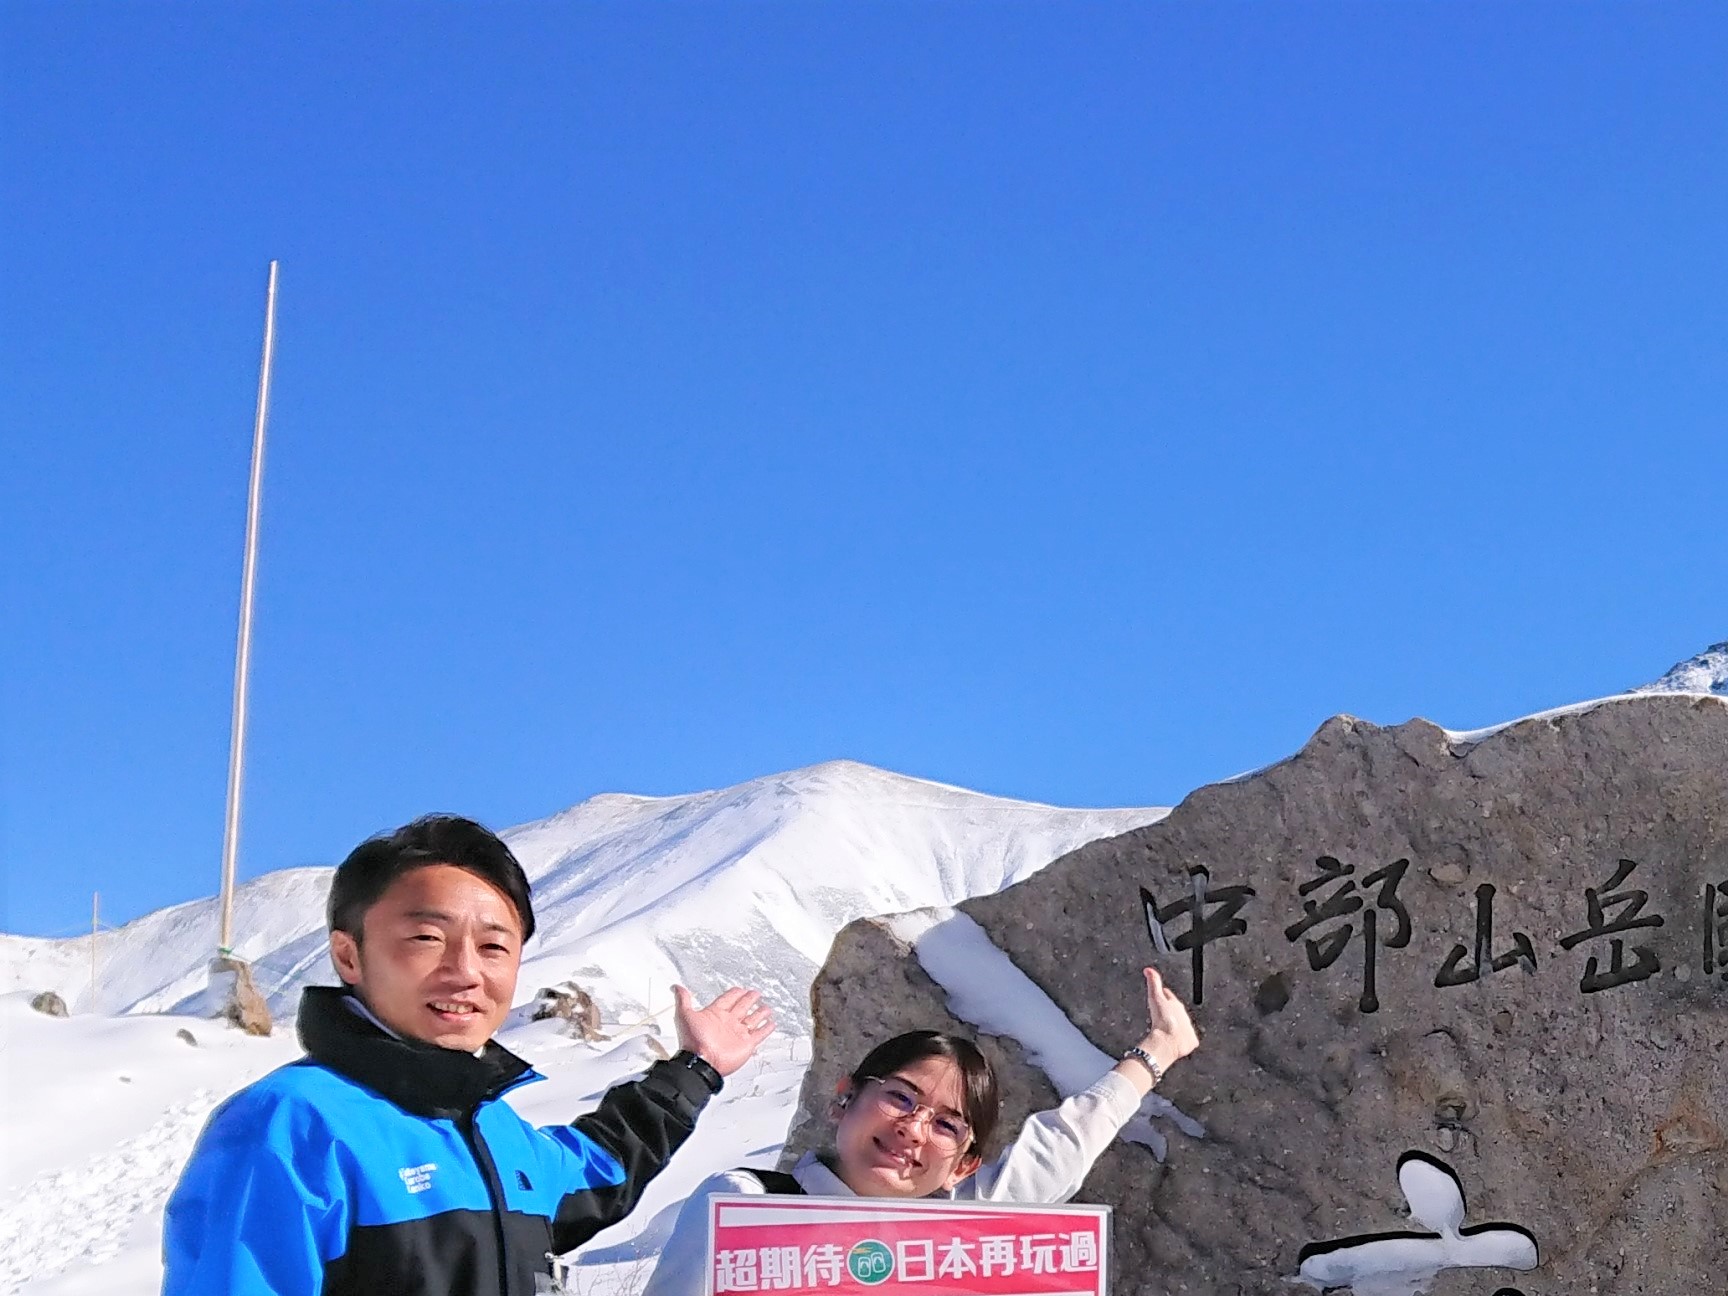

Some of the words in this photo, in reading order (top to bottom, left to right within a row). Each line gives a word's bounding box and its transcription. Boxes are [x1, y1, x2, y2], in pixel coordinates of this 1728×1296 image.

[716, 1244, 845, 1293] 超期待
[896, 1231, 1097, 1284] 日本再玩過
